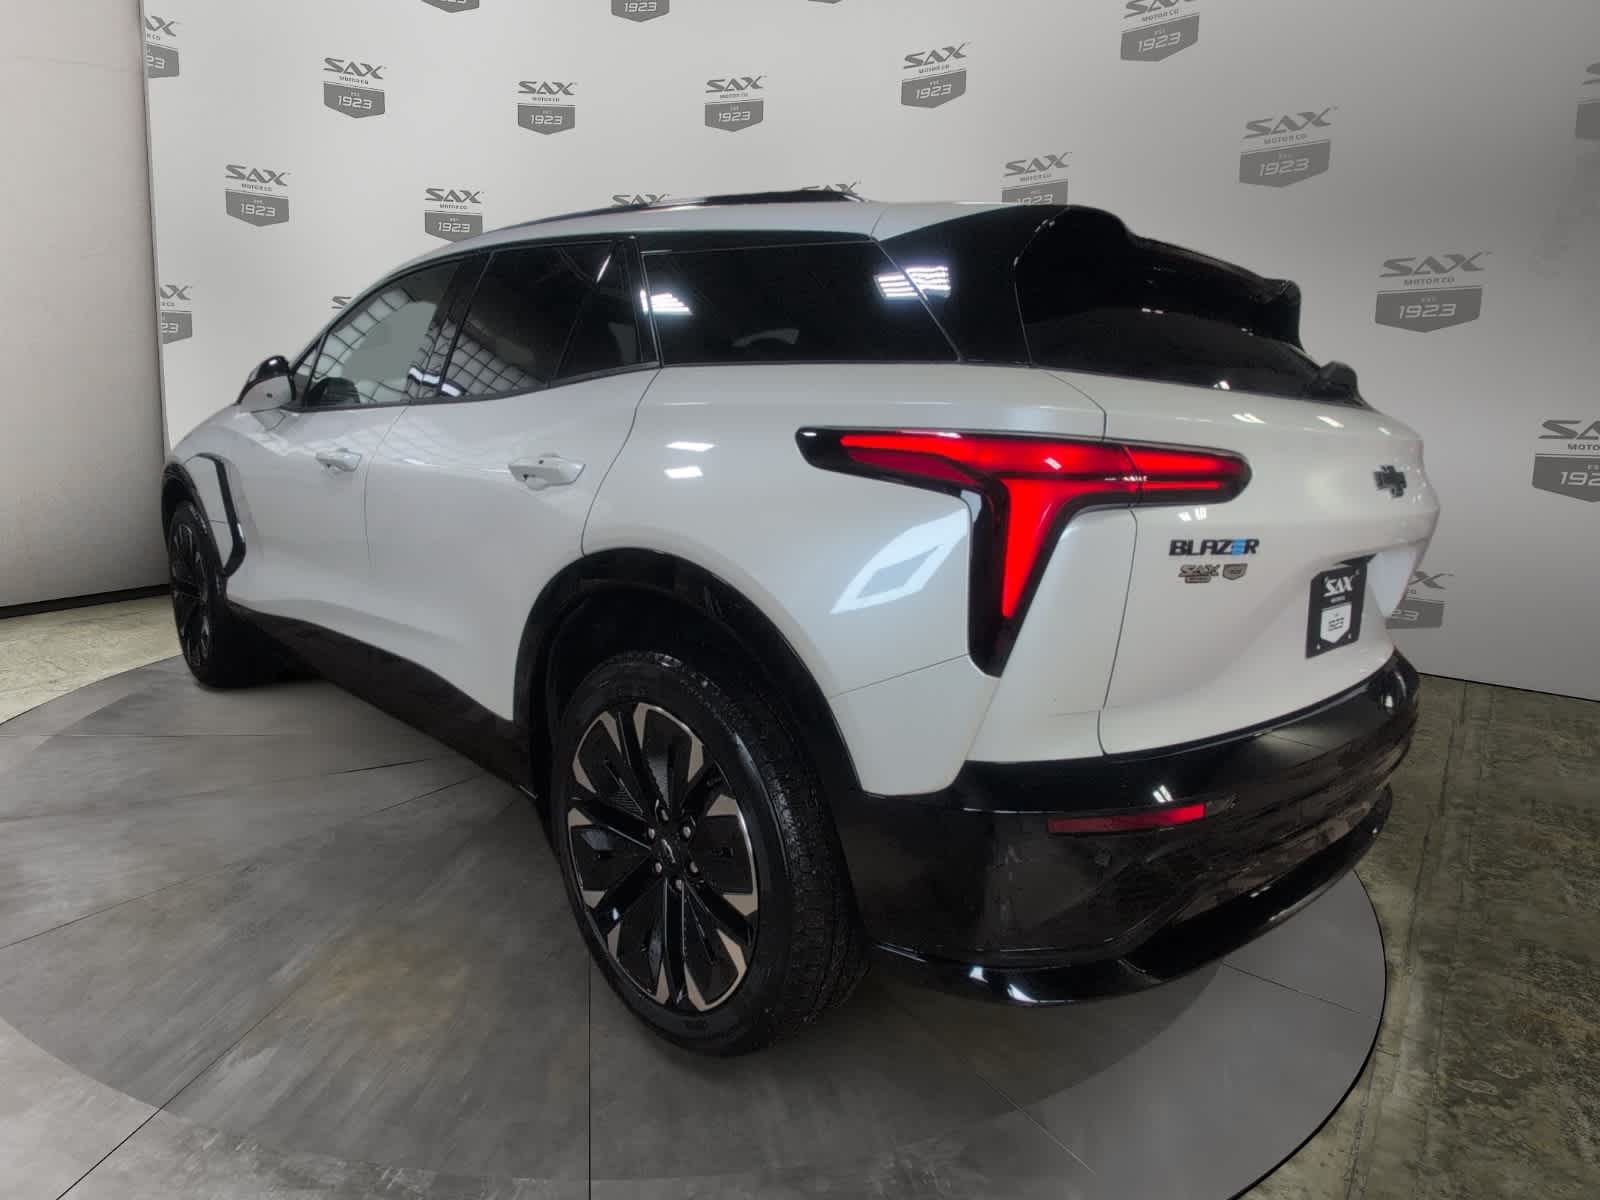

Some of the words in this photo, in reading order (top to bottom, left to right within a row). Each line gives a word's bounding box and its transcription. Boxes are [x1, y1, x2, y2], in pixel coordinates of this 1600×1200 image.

[624, 1, 657, 13] 1923
[1137, 31, 1181, 52] 1923
[903, 43, 968, 69] SAX
[323, 57, 385, 80] SAX
[517, 80, 576, 96] SAX
[705, 76, 765, 93] SAX
[916, 84, 952, 100] 1923
[337, 95, 373, 110] 1923
[530, 114, 563, 125] 1923
[718, 111, 751, 122] 1923
[1242, 107, 1333, 140] SAX
[1004, 152, 1072, 177] SAX
[1258, 158, 1310, 178] 1923
[225, 164, 289, 187] SAX
[425, 188, 483, 204] SAX
[240, 203, 276, 217] 1923
[438, 222, 471, 233] 1923
[1379, 252, 1485, 278] SAX
[1399, 303, 1457, 320] 1923
[1168, 538, 1260, 556] BLAZER
[1323, 576, 1353, 598] SAX
